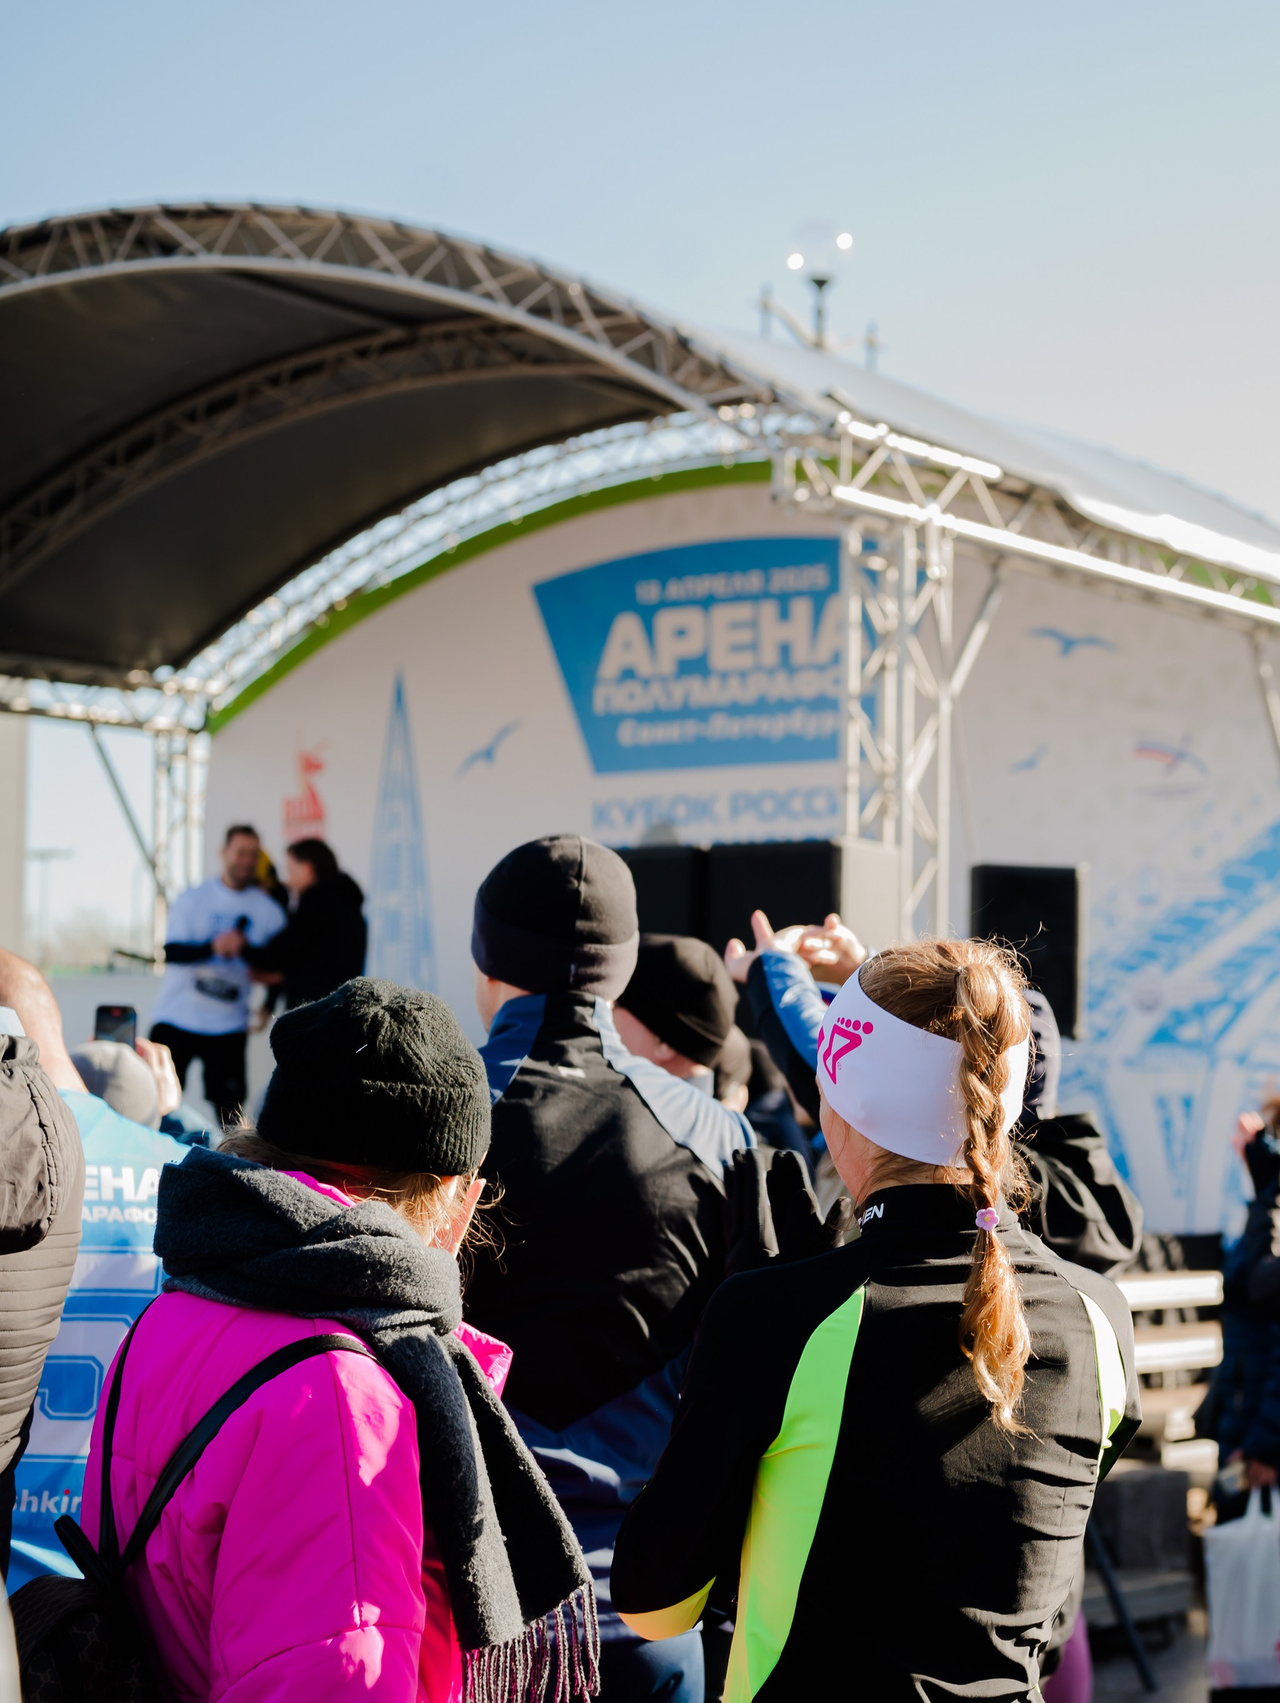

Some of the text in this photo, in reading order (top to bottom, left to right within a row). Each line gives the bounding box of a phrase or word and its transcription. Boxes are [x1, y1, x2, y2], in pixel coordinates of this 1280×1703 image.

[593, 663, 846, 716] ПОЛУМАРАФО
[616, 706, 843, 747] Санкт-Петербур
[83, 1165, 159, 1203] ЕНА
